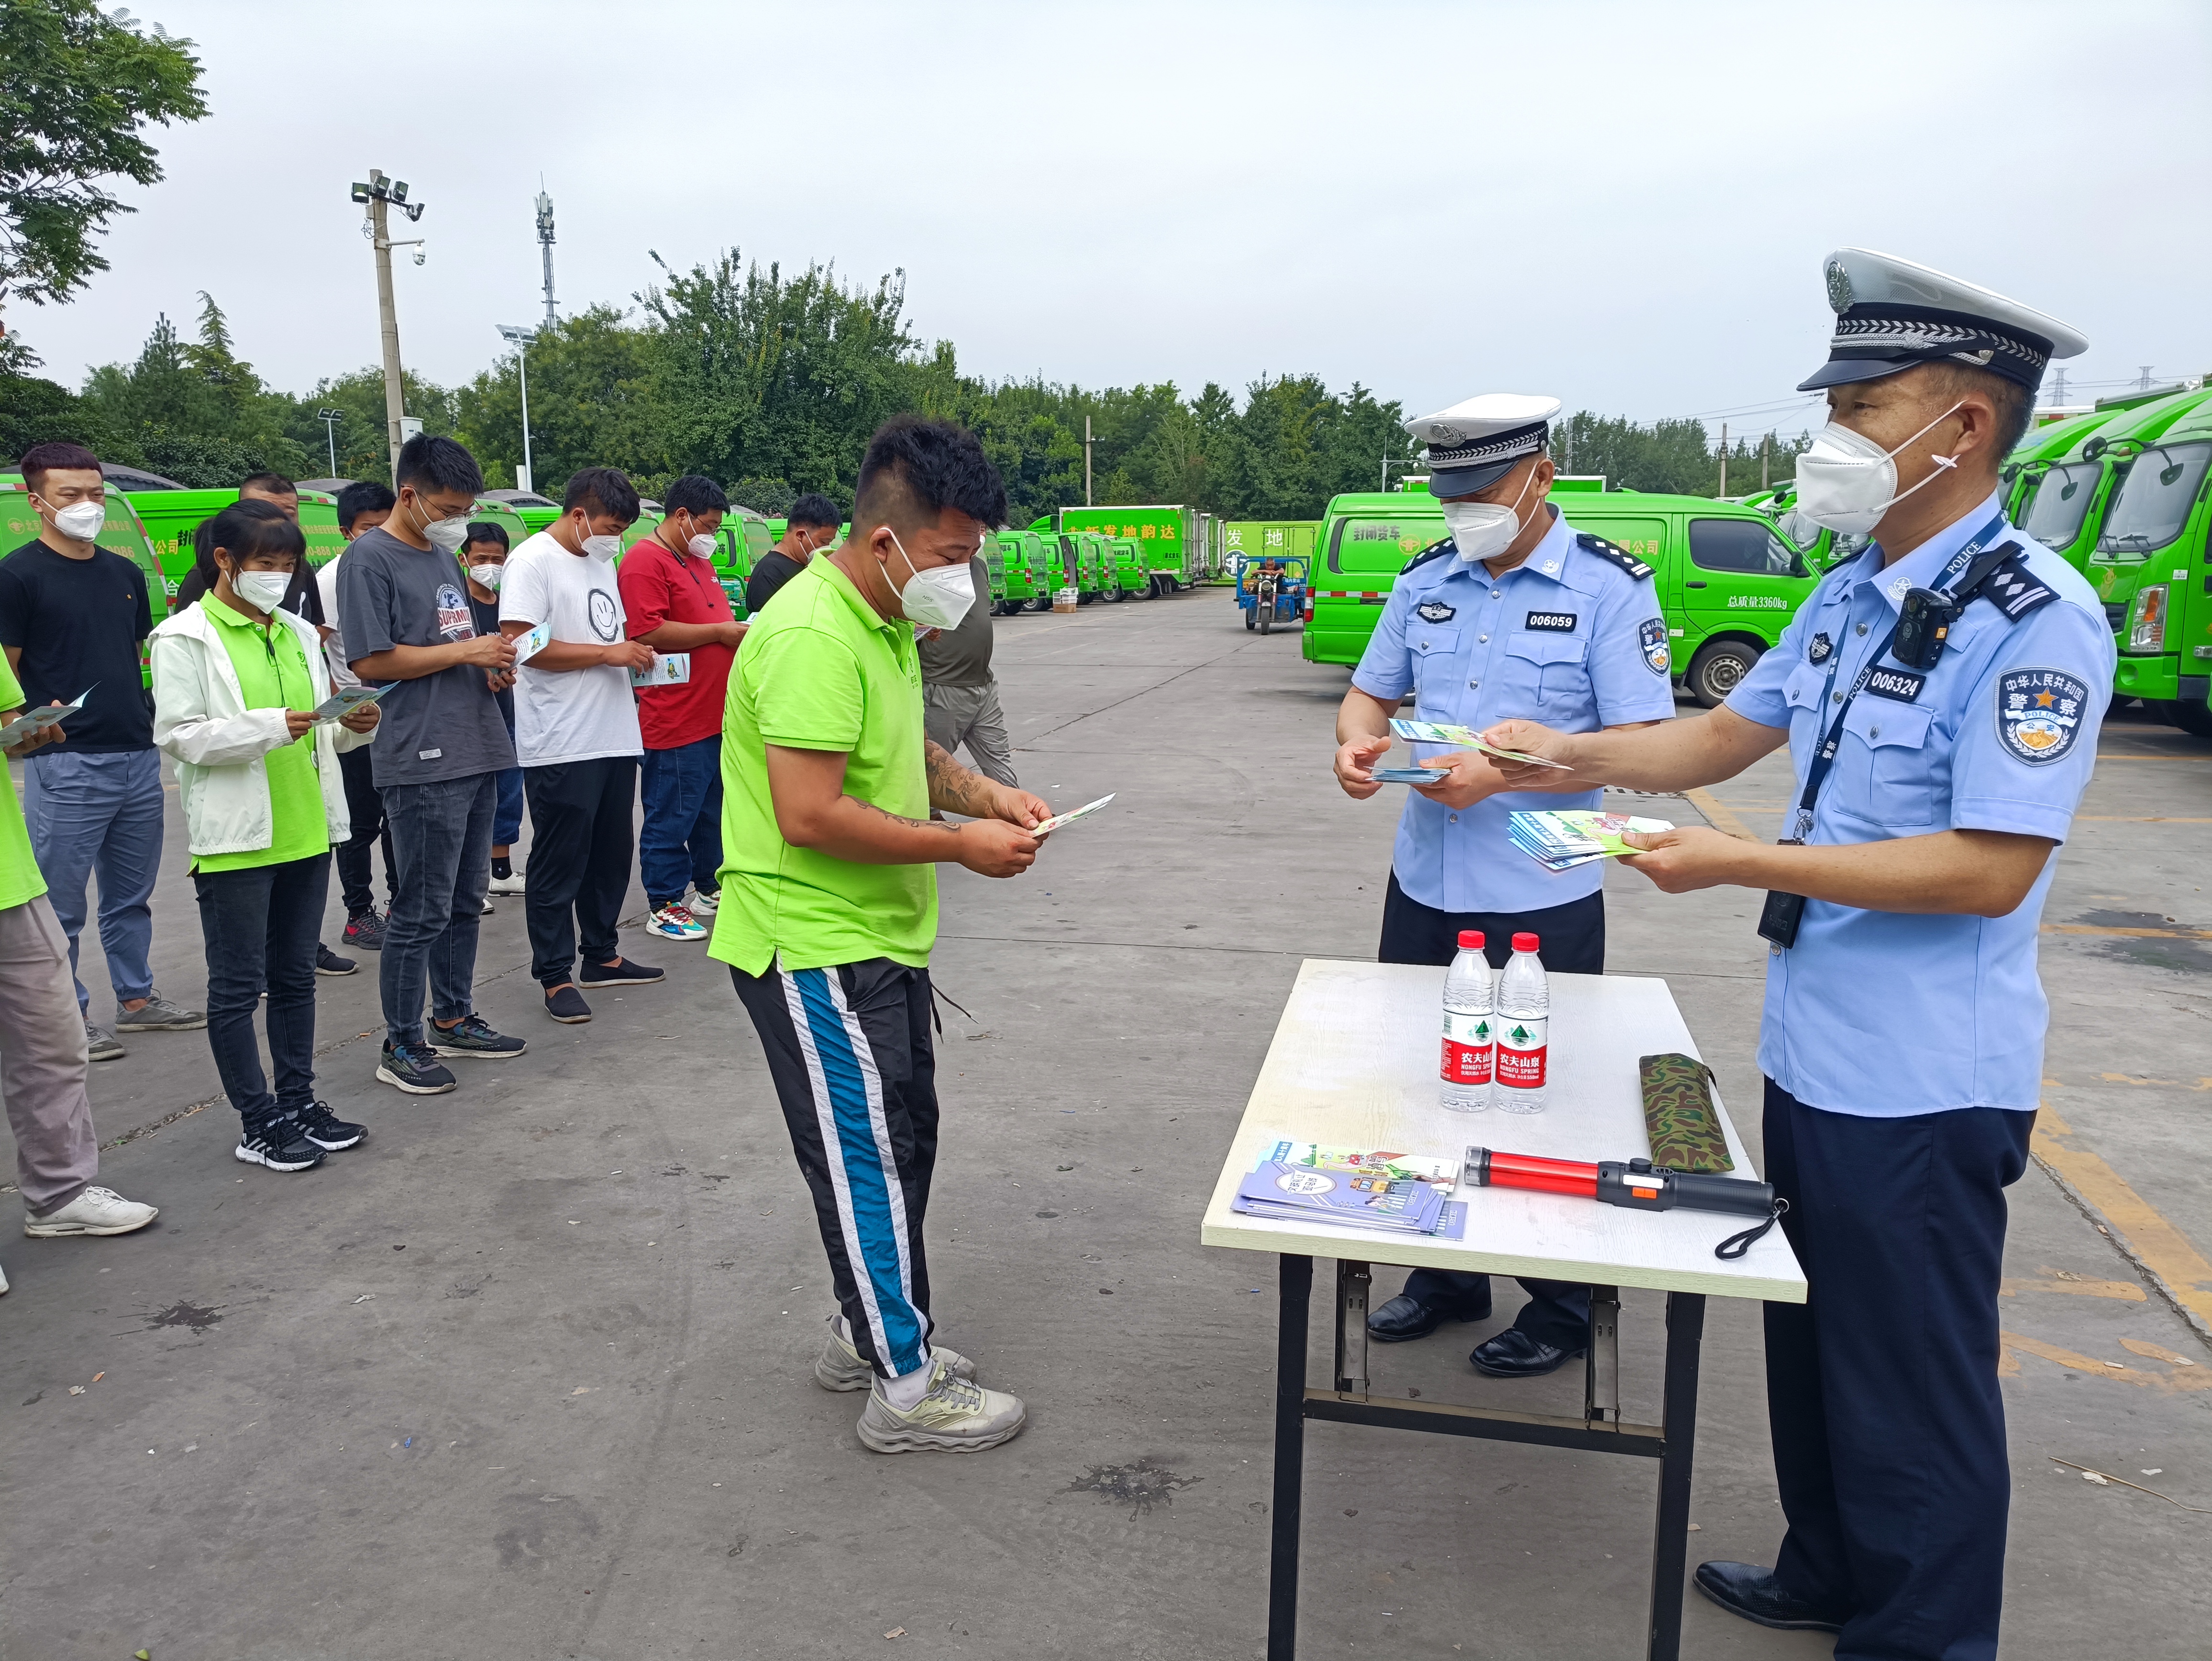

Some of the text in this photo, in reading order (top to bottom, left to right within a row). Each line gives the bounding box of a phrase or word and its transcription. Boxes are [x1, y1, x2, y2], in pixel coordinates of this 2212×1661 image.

[1353, 525, 1401, 541] 封闭货车
[151, 540, 179, 555] 公司
[1947, 541, 1982, 574] POLICE
[1727, 595, 1788, 610] 总质量3360kg
[1530, 615, 1573, 628] 006059
[1848, 666, 1871, 700] POLICE
[1871, 672, 1919, 696] 006324
[2005, 673, 2085, 702] 中华人民共和国
[2024, 711, 2061, 723] POLICE
[1500, 1053, 1539, 1067] 农夫山泉
[1500, 1064, 1519, 1074] NONGFU
[1288, 1174, 1305, 1192] 文明礼让
[1302, 1177, 1318, 1191] 斑马线
